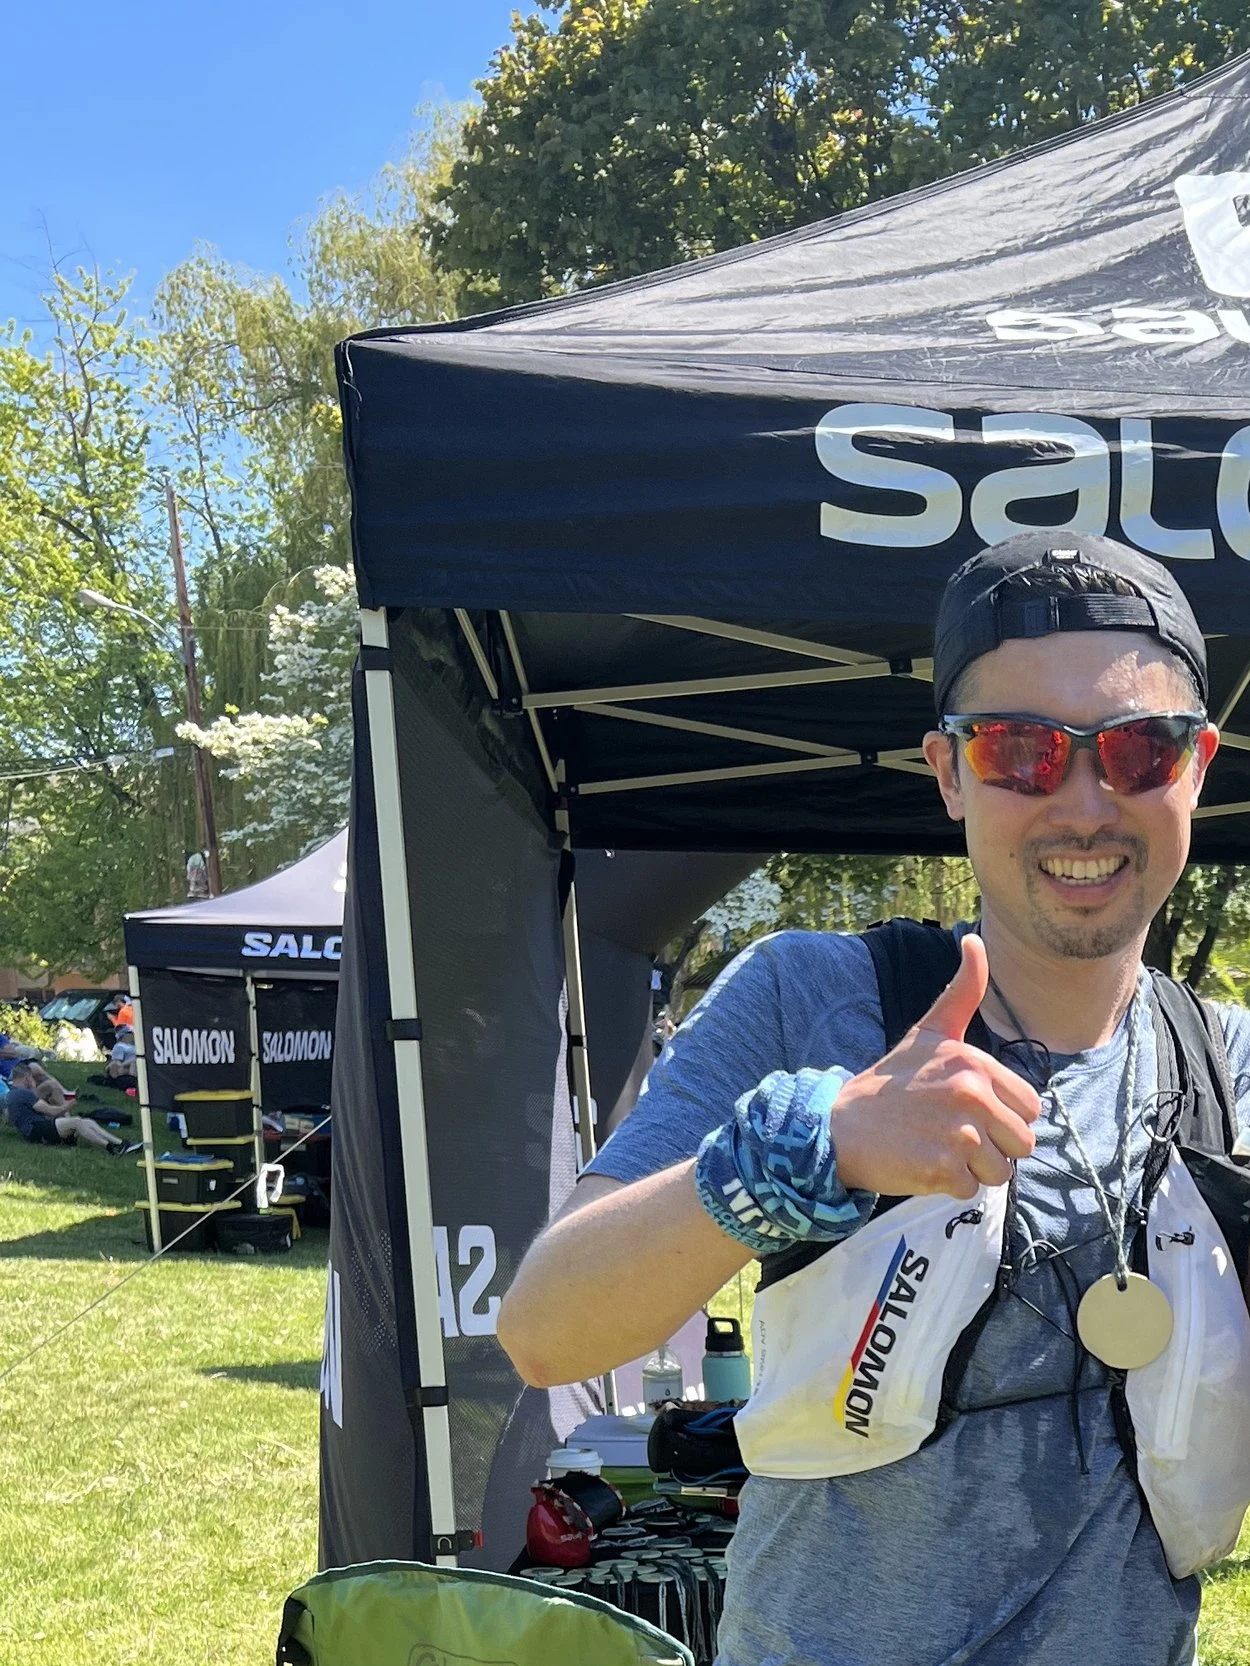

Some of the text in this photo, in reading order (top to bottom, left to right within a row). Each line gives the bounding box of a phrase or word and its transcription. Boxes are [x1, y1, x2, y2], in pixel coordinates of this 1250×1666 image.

[152, 1026, 236, 1065] SALOMON
[262, 1030, 333, 1065] SALOMON
[845, 1248, 930, 1439] SALOMON
